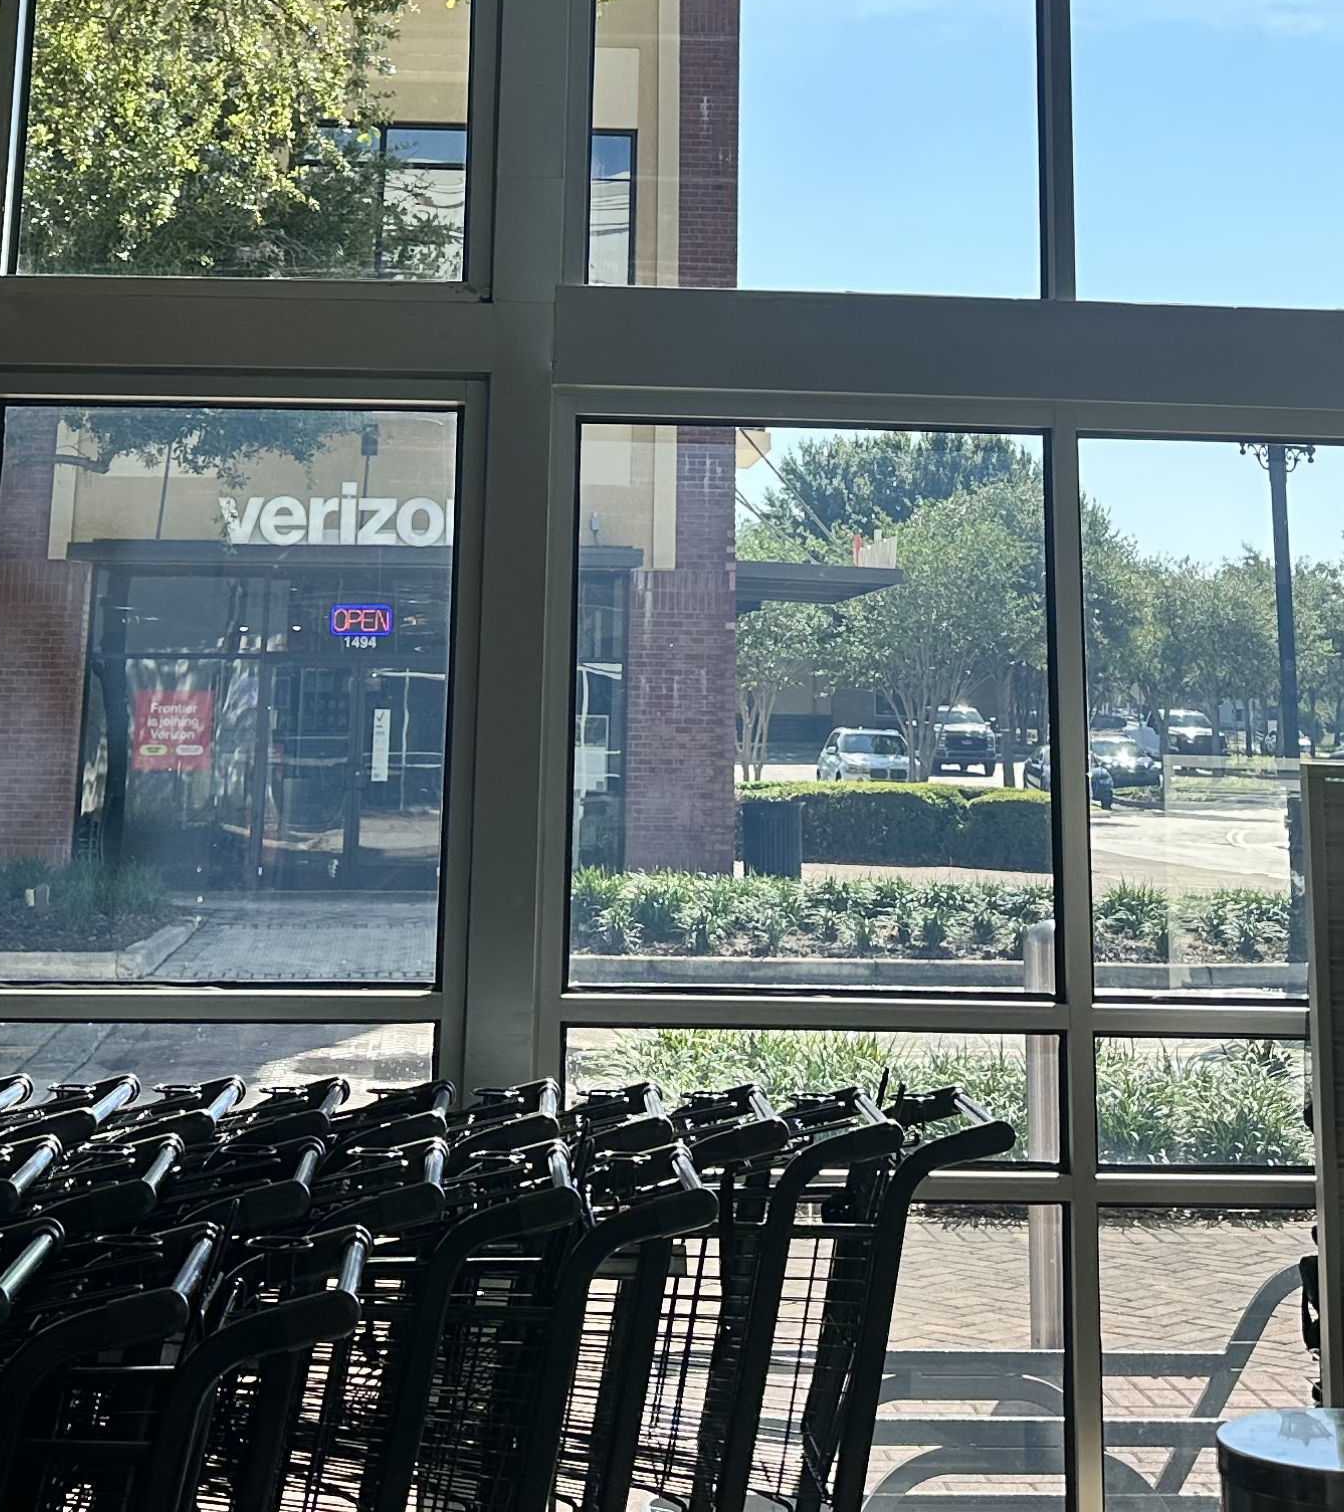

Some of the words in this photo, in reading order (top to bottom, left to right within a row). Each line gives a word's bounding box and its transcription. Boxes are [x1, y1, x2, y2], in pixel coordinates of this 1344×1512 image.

[218, 481, 454, 547] verizo
[333, 607, 391, 633] OPEN
[344, 636, 378, 649] 1494
[150, 702, 198, 714] Frontier
[150, 728, 196, 740] Verizon
